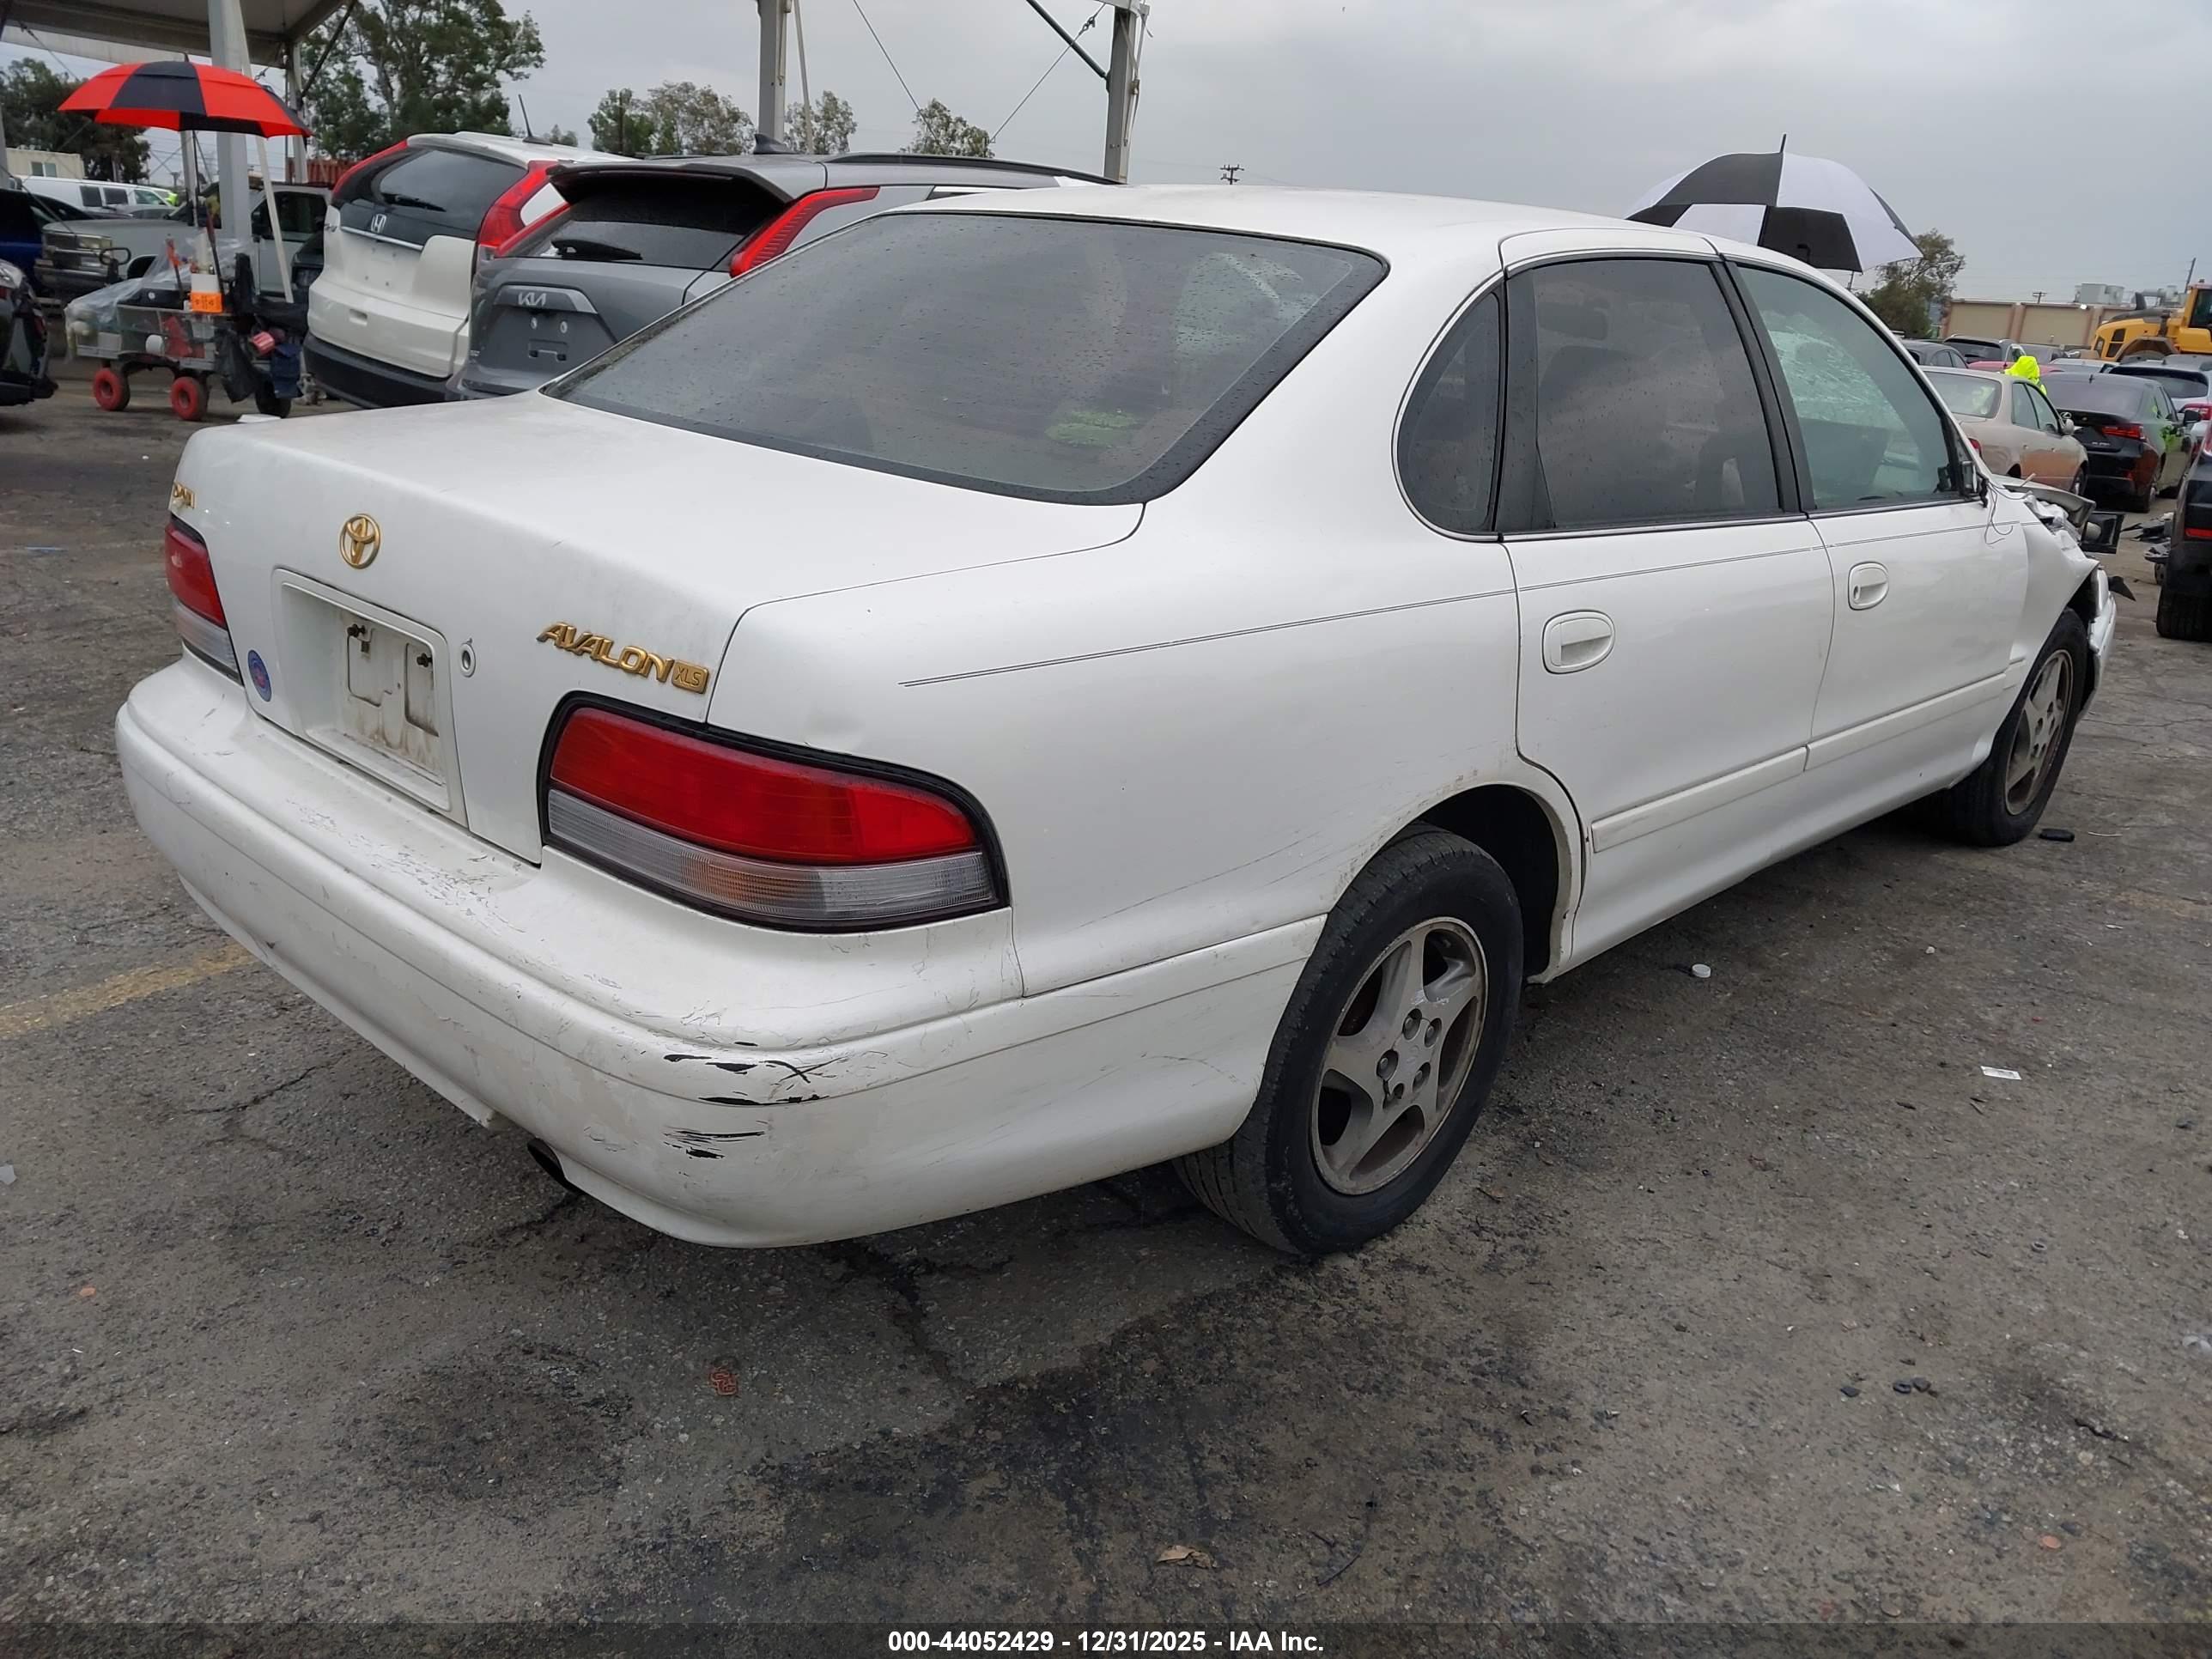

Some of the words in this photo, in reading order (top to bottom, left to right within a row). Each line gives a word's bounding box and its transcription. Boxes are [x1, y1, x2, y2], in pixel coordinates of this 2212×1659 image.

[518, 291, 547, 307] KIA
[536, 622, 675, 683] AVALON
[674, 664, 703, 688] XLS
